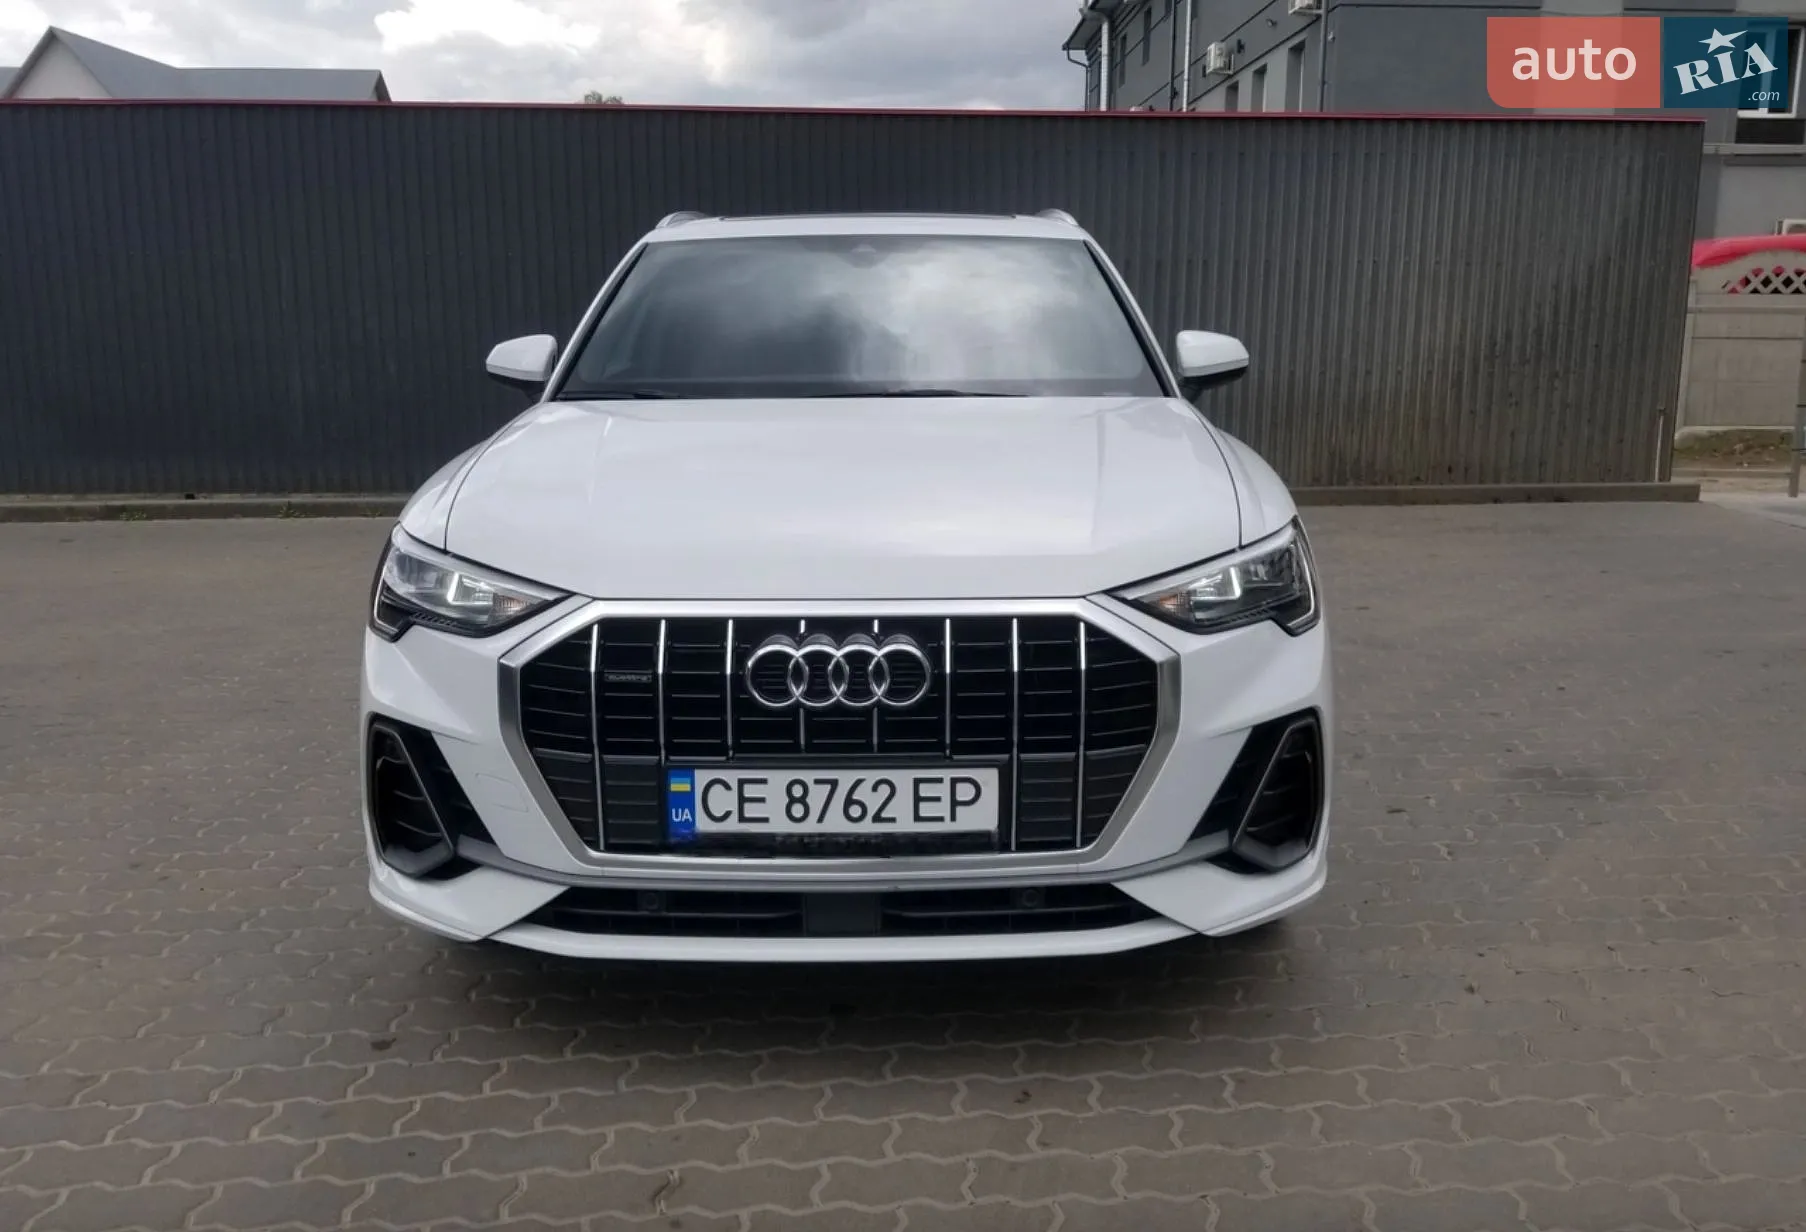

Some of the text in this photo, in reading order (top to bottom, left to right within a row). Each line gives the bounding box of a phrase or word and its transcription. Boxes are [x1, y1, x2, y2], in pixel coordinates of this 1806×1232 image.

[672, 808, 693, 822] UA
[701, 777, 982, 824] CE 8762 EP
